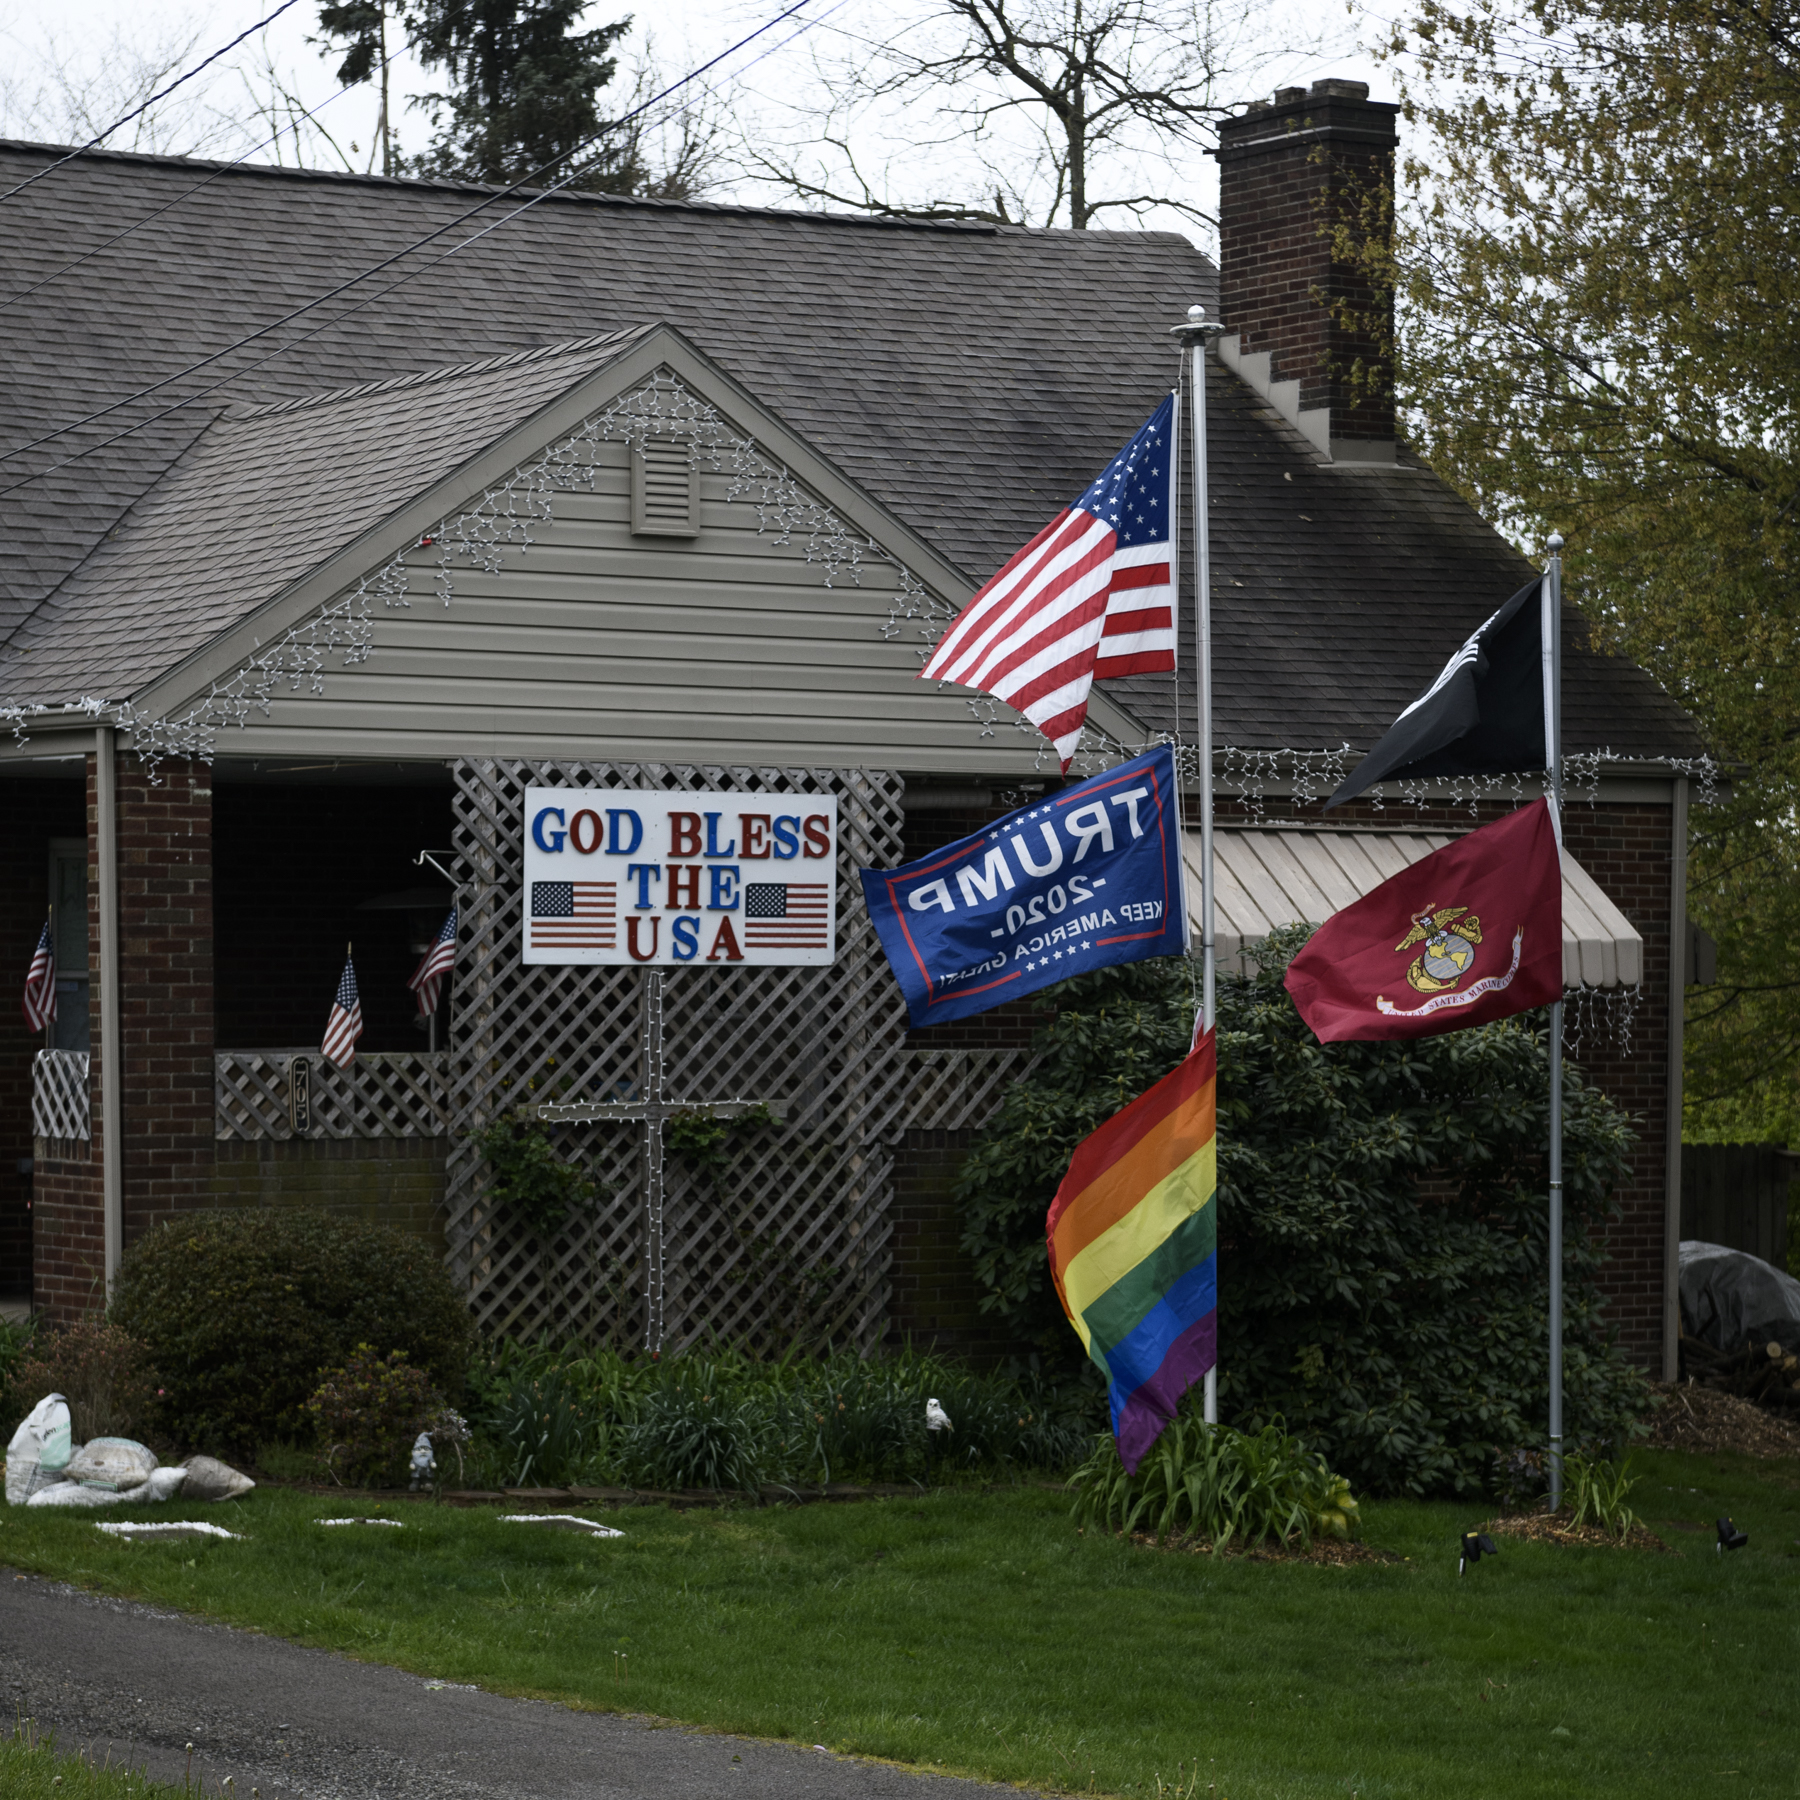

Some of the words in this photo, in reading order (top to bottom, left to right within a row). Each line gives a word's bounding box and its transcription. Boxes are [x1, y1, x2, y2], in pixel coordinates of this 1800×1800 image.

[532, 807, 643, 854] GOD
[667, 811, 831, 859] BLESS
[628, 863, 740, 910] THE
[625, 915, 744, 961] USA
[1428, 995, 1465, 1010] STATES
[1468, 980, 1501, 999] MARINE
[1502, 956, 1519, 987] CORPS
[295, 1070, 307, 1119] 705
